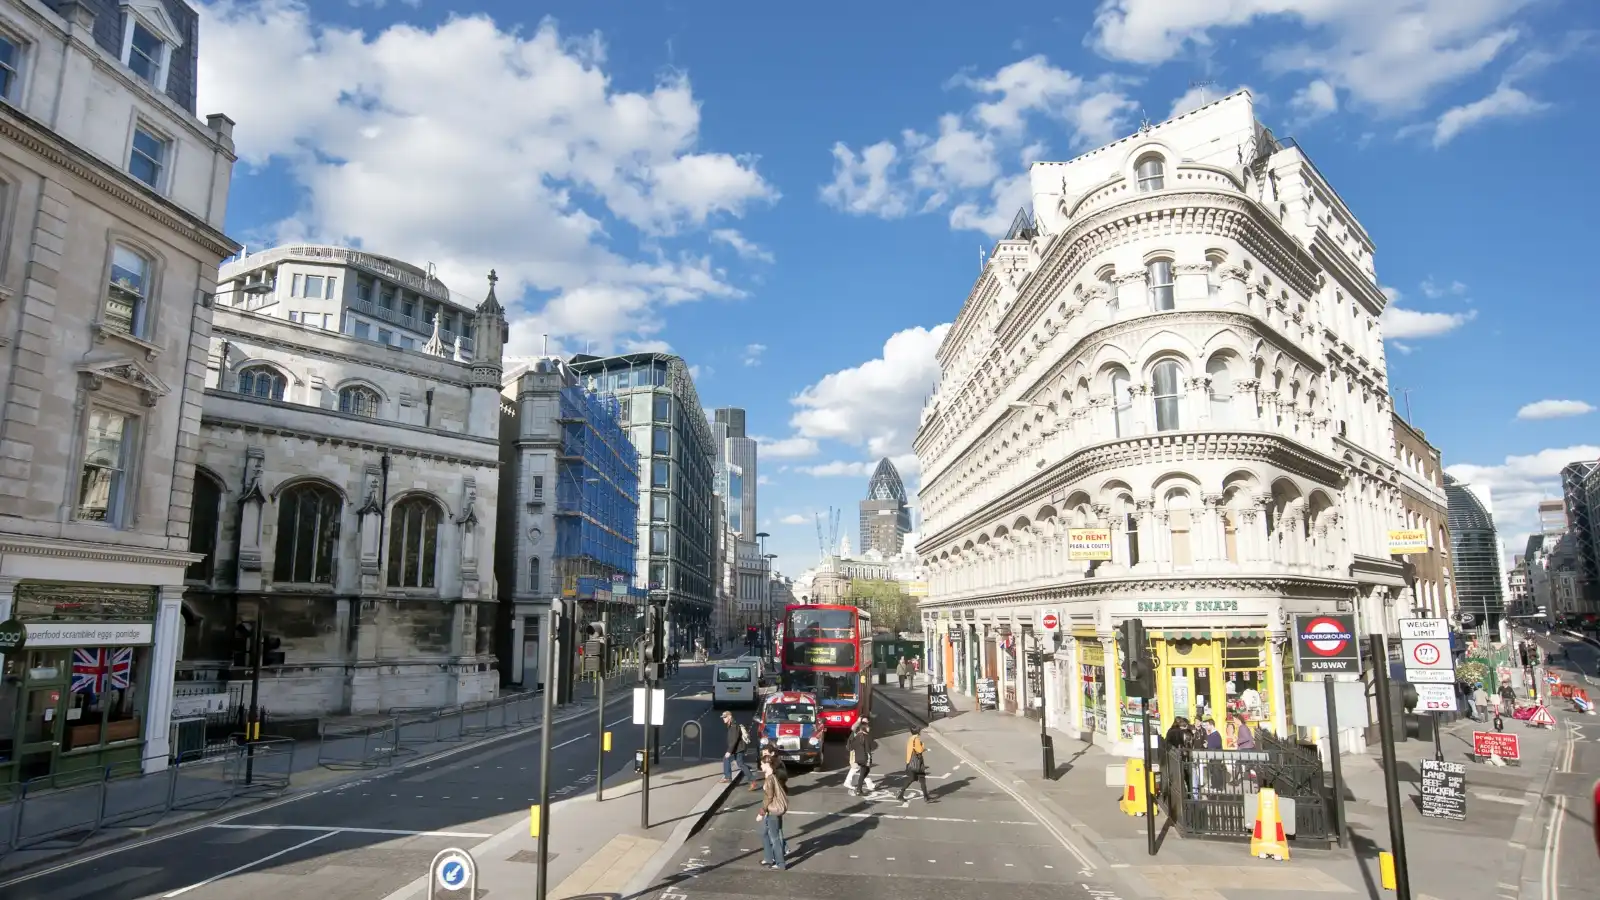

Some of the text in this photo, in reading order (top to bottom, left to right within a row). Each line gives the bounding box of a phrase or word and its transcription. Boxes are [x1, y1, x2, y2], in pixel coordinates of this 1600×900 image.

[1137, 600, 1238, 612] SNAPPY SNAPS
[26, 629, 140, 640] uperfood scrambled eggs porridge
[1311, 661, 1347, 669] SUBWAY
[1422, 770, 1446, 781] LAMB
[1422, 778, 1443, 788] BEEF
[1422, 785, 1455, 798] CHICKEN
